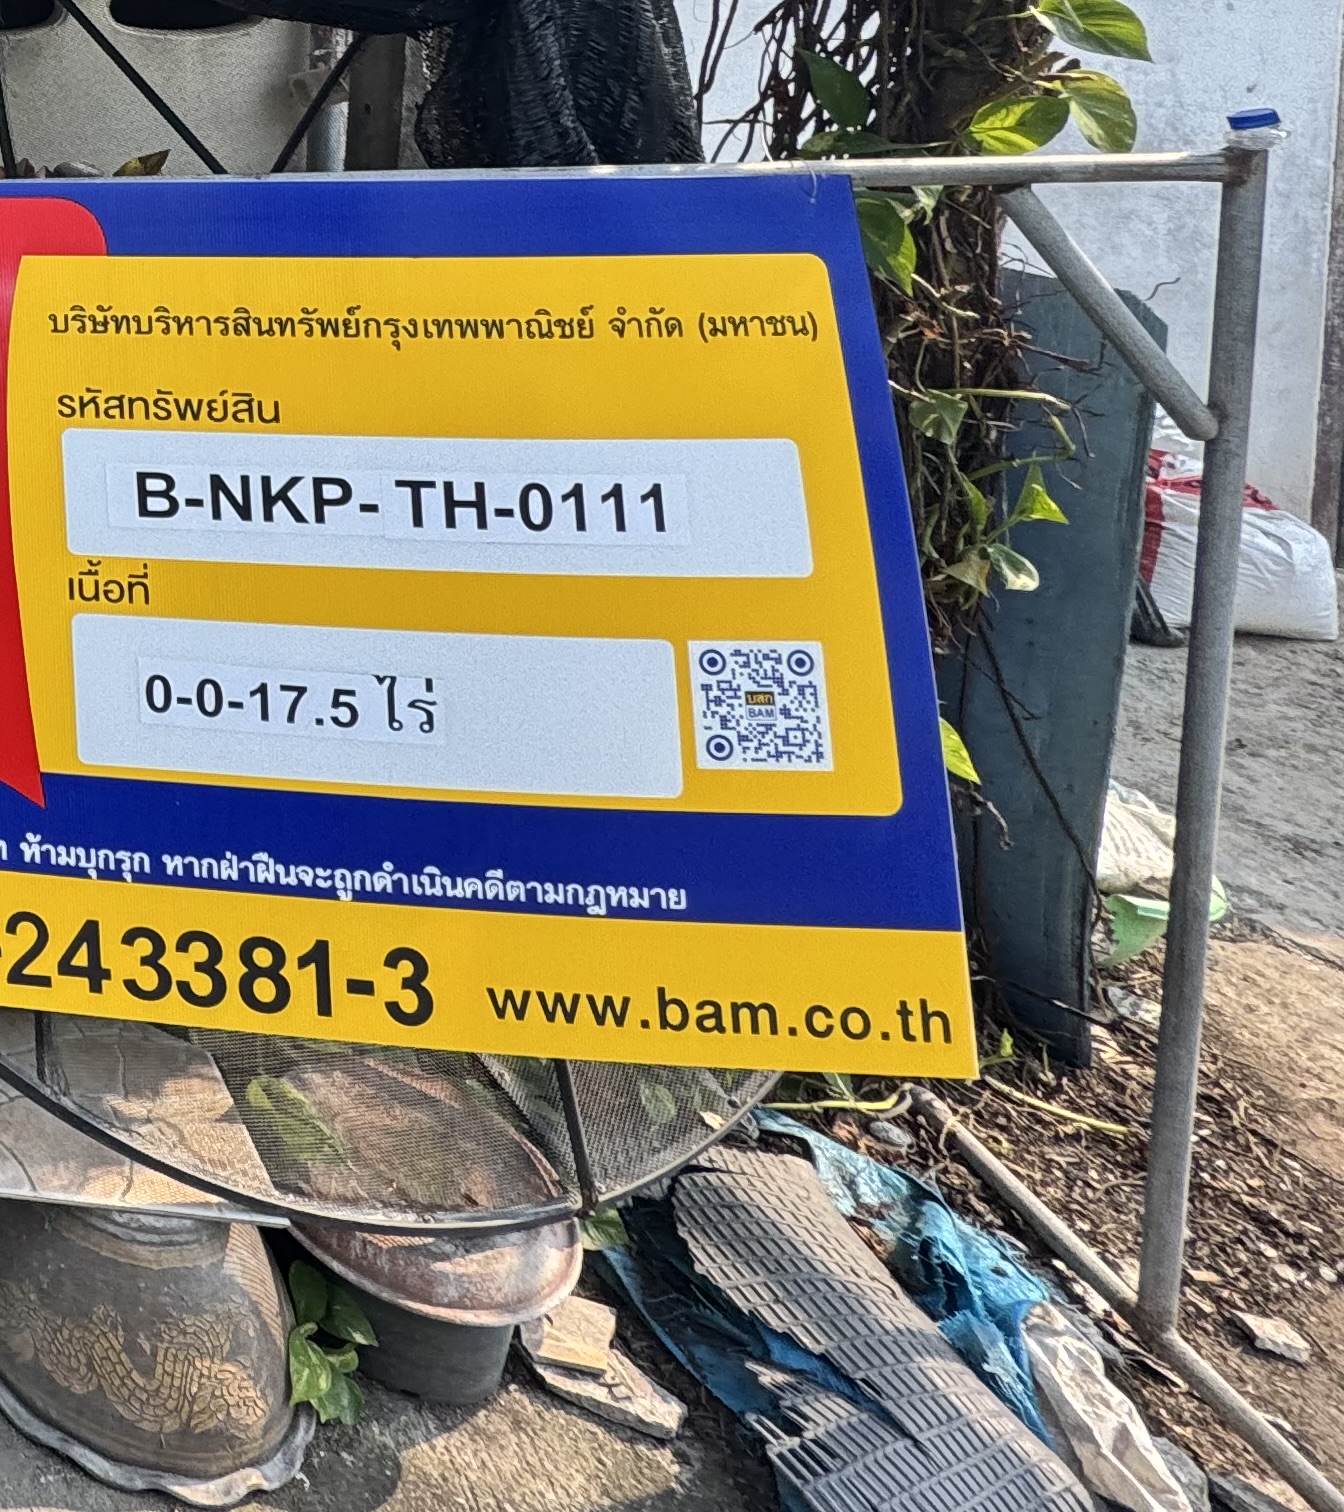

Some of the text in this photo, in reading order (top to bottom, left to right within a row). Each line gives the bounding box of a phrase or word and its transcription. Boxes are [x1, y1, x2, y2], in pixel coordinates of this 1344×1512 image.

[47, 303, 819, 352] บริษัทบริหารสินทรัพย์กรุงเทพพาณิชย์ จำกัด (มหาชน)
[56, 387, 282, 425] รหัสทรัพย์สิน
[66, 559, 151, 606] เนื้อที่
[144, 671, 439, 736] 0-0-17.5 ไร่
[747, 693, 773, 704] บสก
[748, 708, 774, 718] BAM
[19, 831, 152, 885] ห้ามบุกรุก
[161, 850, 688, 917] หากฝ่าฝืนจะถูกดำเนินคดีตามกฎหมาย
[485, 985, 954, 1046] www.bam.co.th
